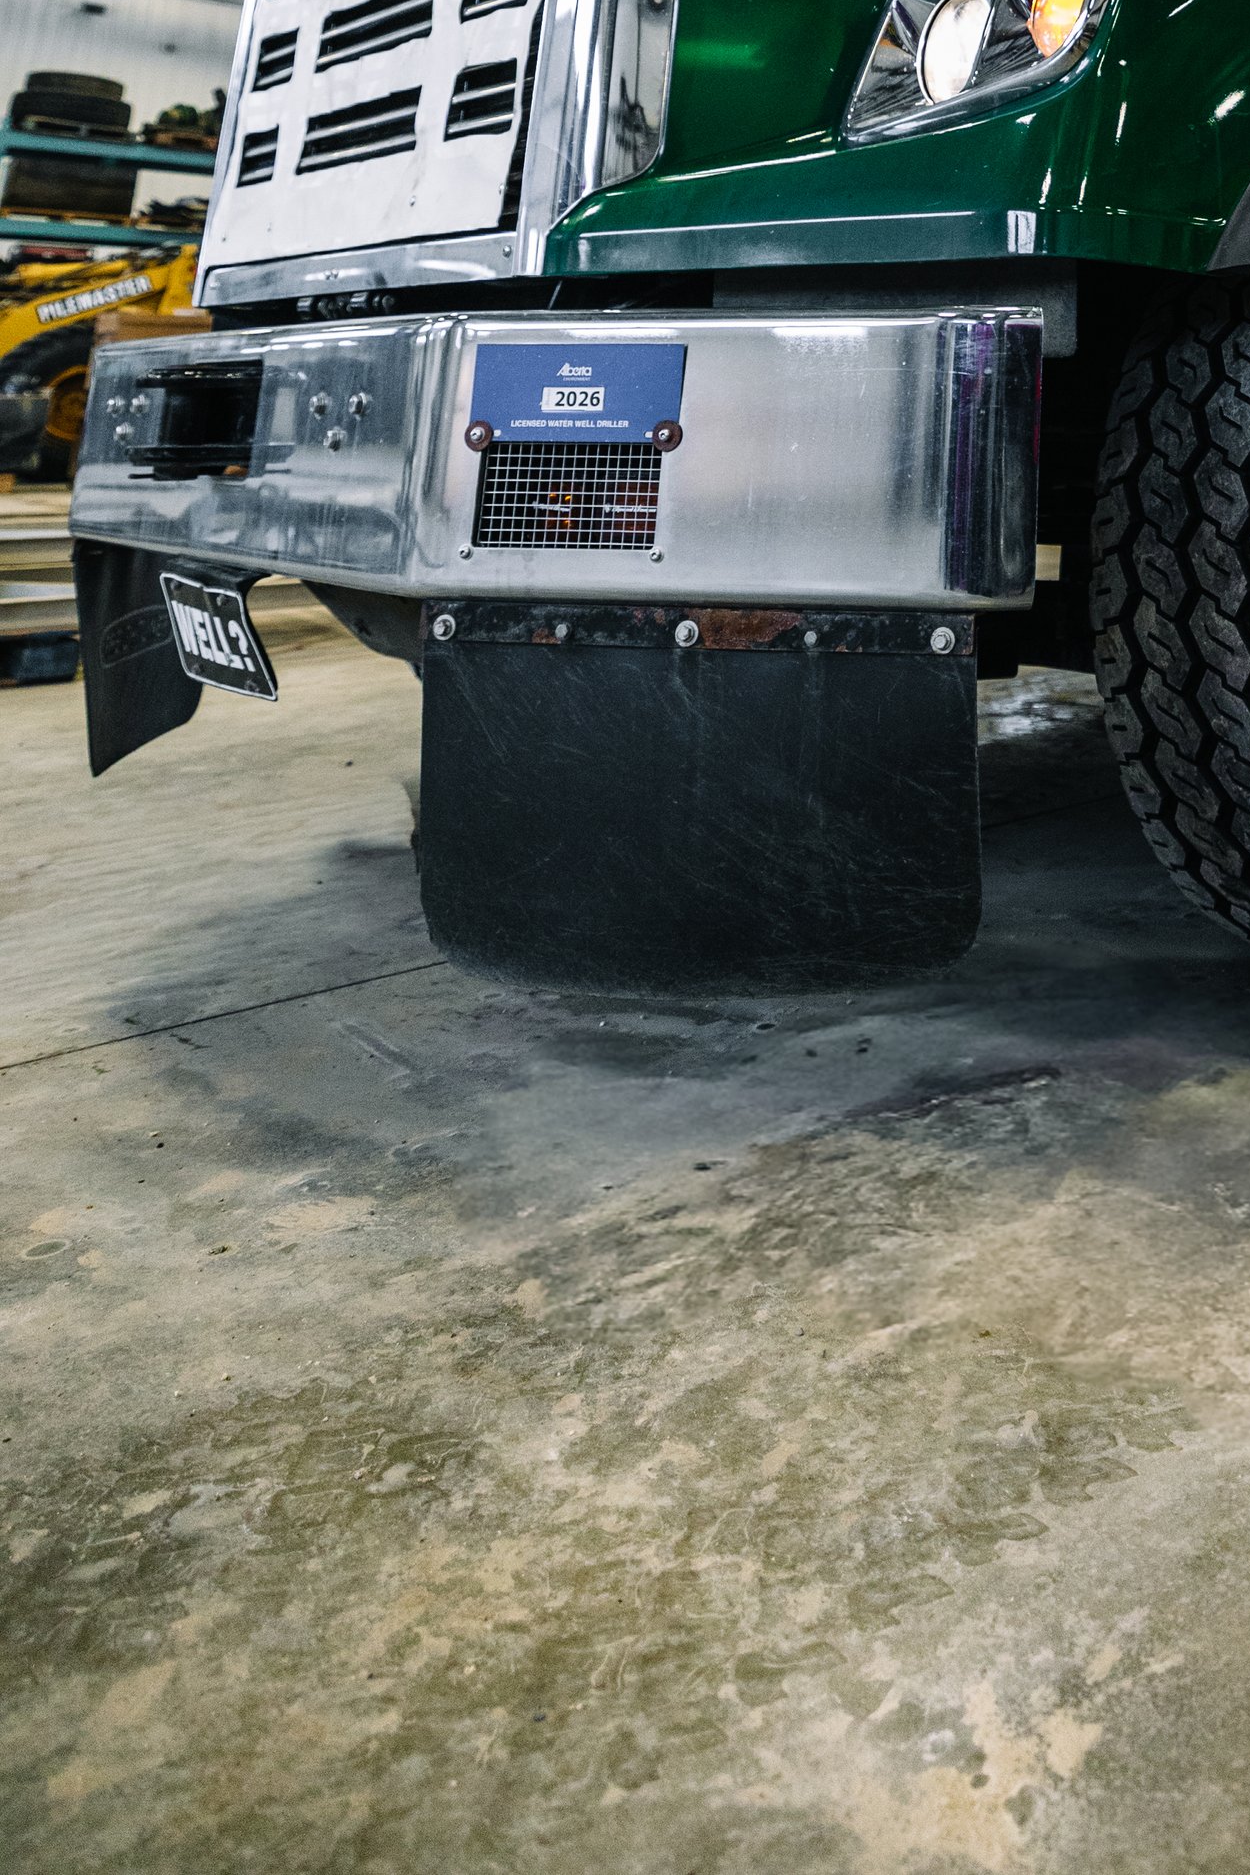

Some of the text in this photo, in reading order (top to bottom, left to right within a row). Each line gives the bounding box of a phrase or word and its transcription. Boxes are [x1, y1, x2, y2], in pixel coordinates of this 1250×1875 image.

[37, 275, 153, 323] PILEMASTER
[556, 362, 592, 376] Alberta
[555, 391, 600, 407] 2026
[511, 419, 629, 428] LICENSED WATER WELL DRILLER
[170, 600, 257, 672] WELL?
